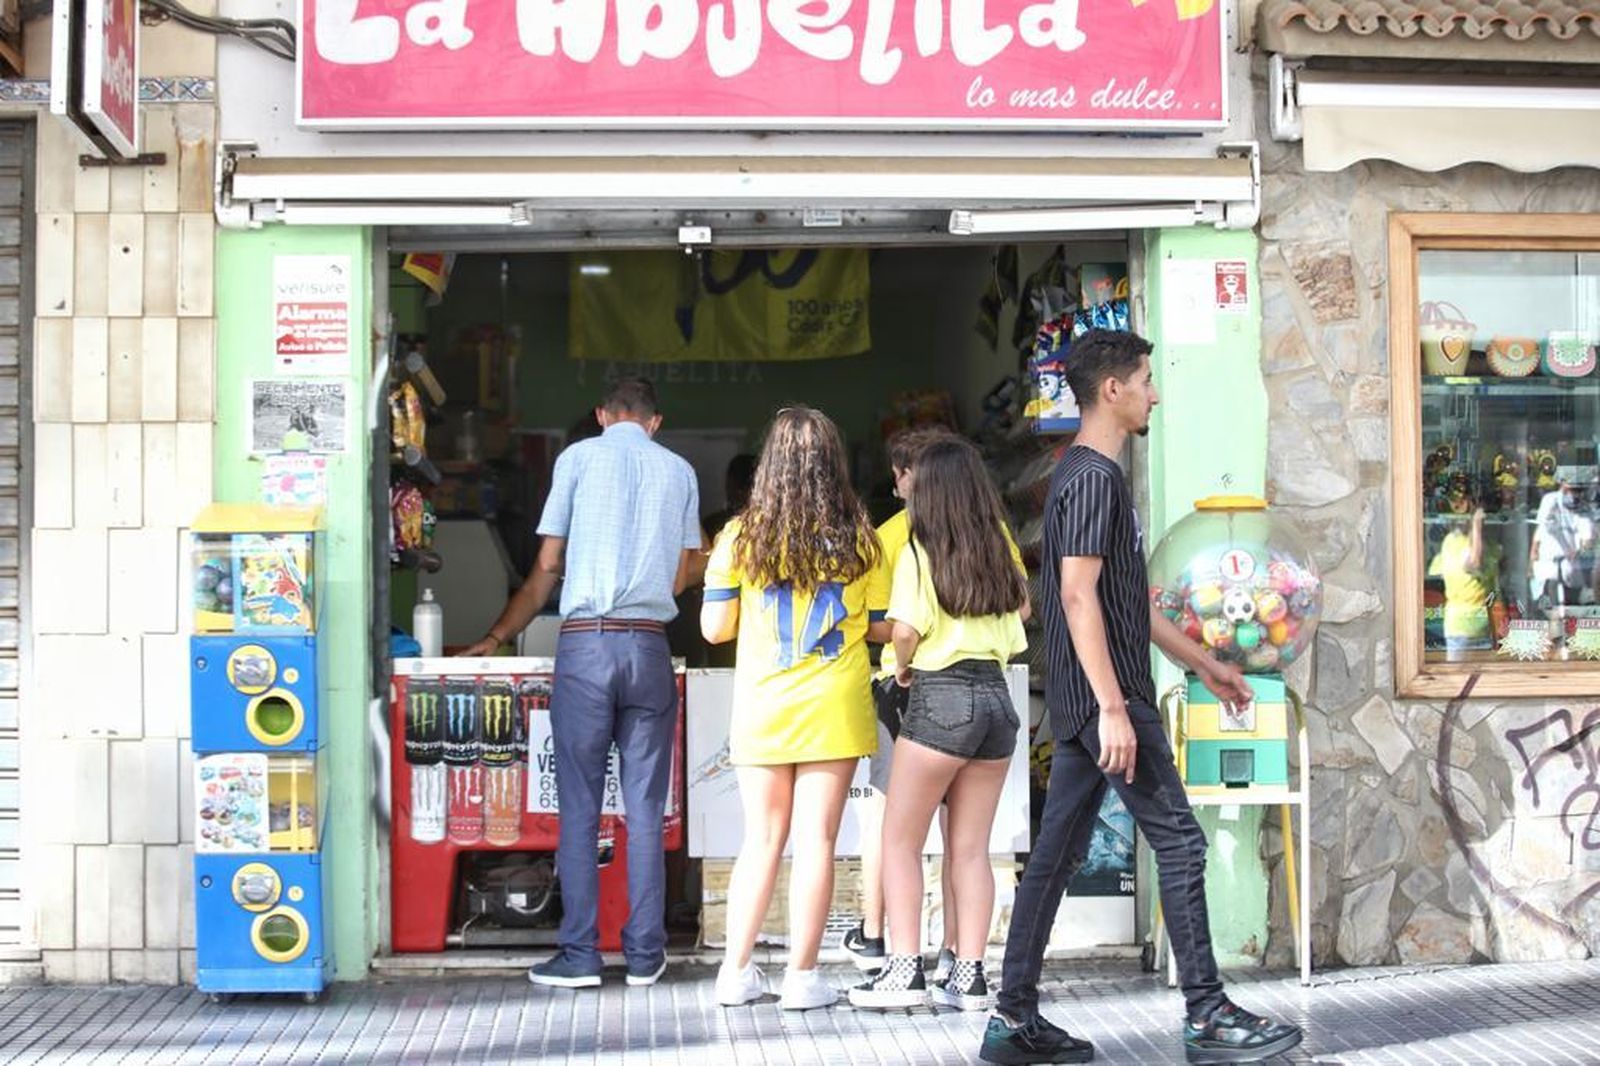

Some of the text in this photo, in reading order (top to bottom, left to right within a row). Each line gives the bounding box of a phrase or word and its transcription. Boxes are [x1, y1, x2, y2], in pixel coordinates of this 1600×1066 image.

[315, 0, 474, 65] La
[966, 75, 995, 108] lo
[1009, 86, 1077, 108] mas
[277, 283, 346, 295] verisure
[788, 300, 818, 316] 100
[763, 580, 848, 669] 14
[537, 753, 557, 774] VE
